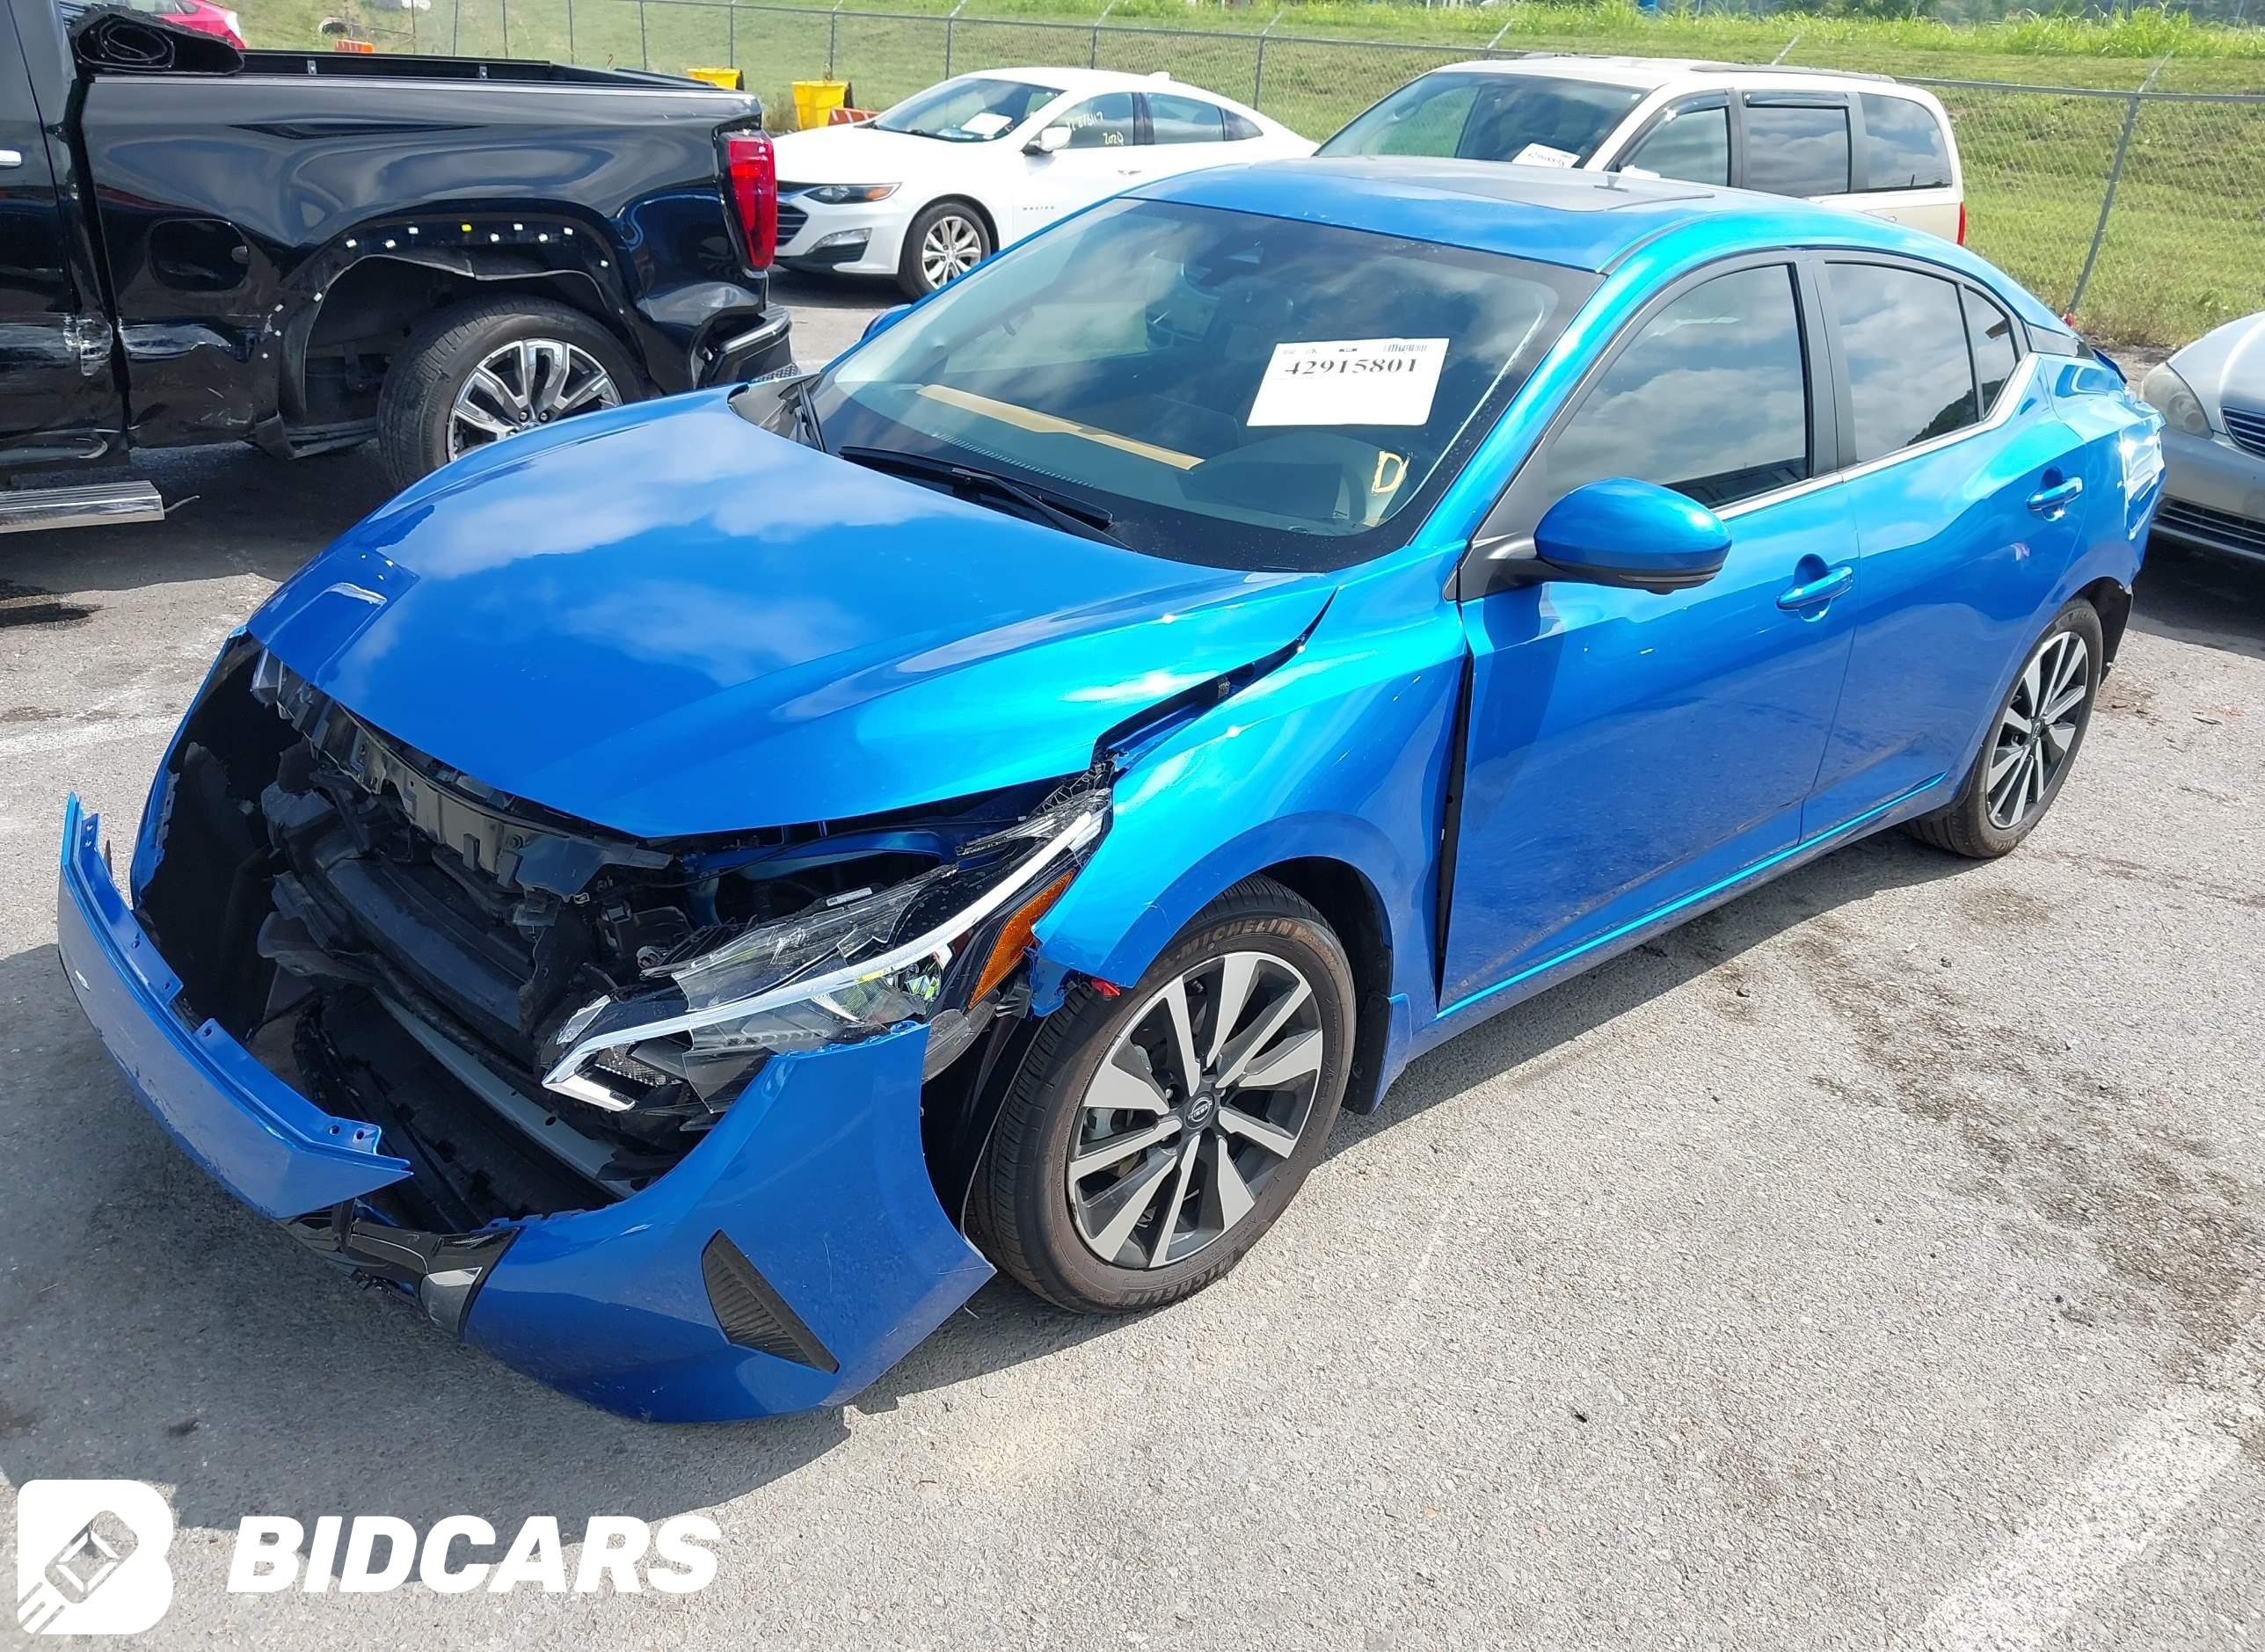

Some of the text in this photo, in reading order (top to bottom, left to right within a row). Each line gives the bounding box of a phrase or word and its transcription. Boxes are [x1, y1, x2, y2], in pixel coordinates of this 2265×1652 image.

[1285, 358, 1417, 375] 42915801
[1372, 450, 1409, 495] D
[1181, 919, 1293, 958] MICHELIN
